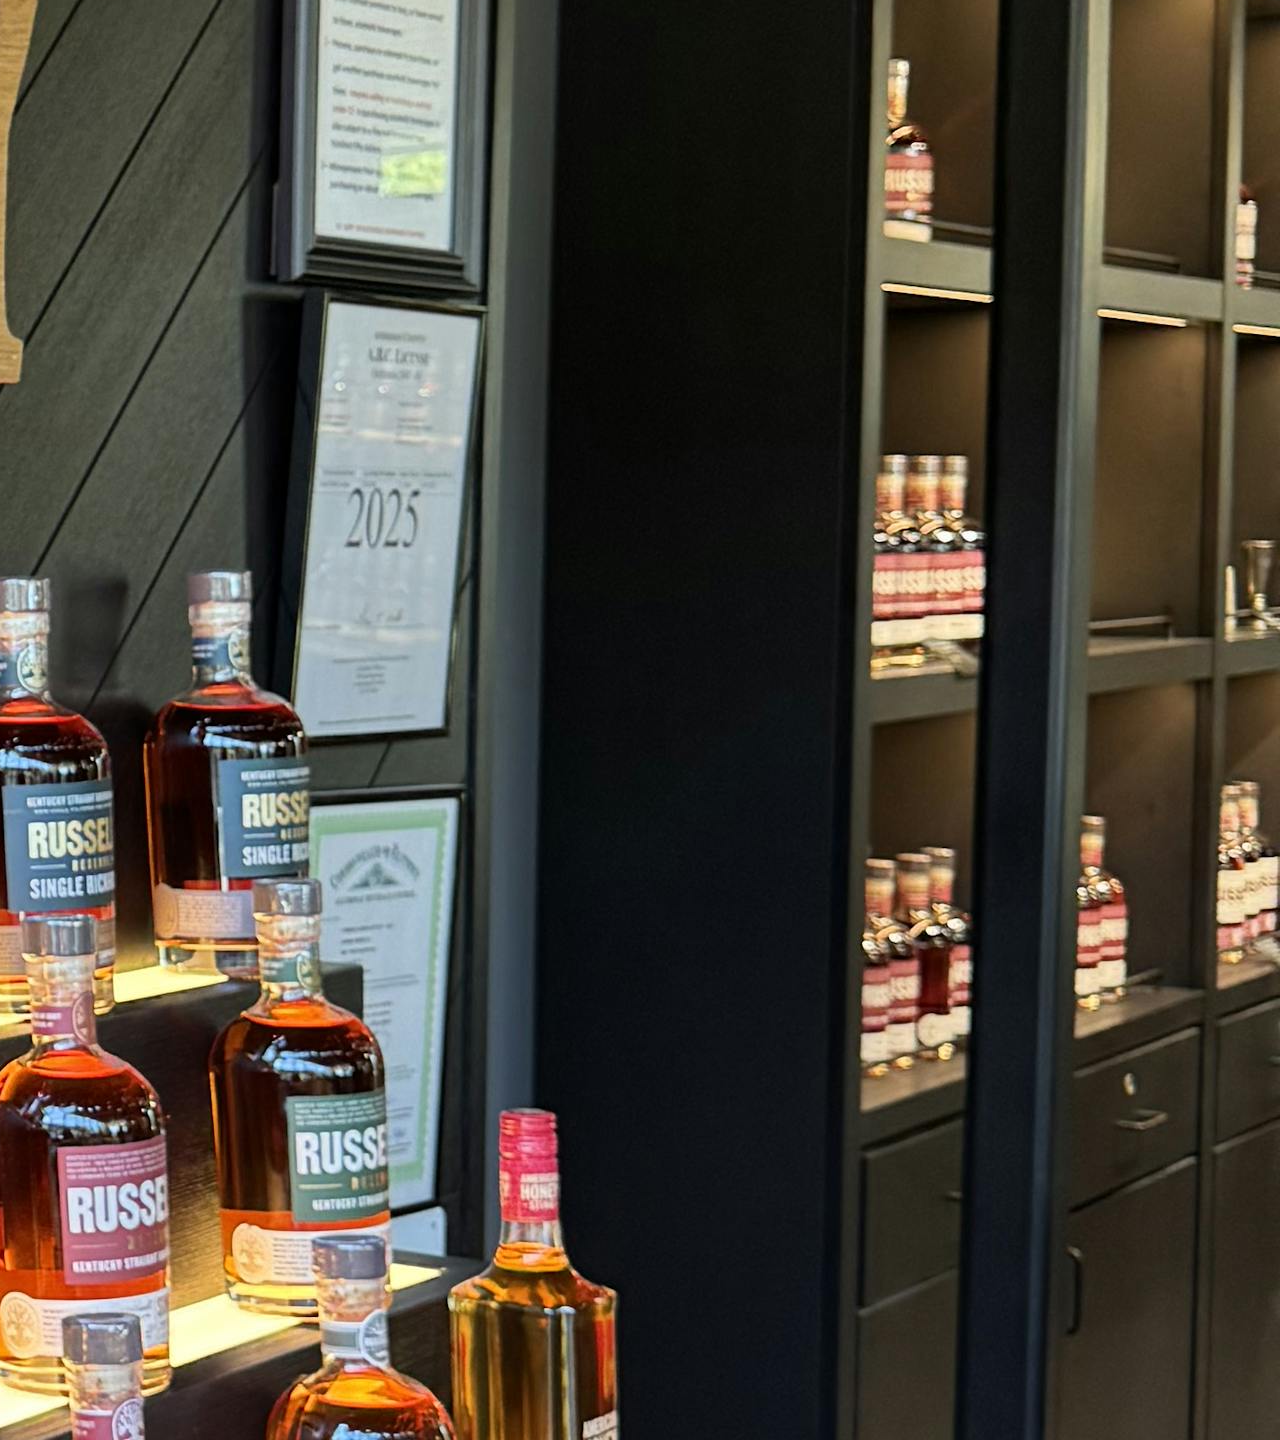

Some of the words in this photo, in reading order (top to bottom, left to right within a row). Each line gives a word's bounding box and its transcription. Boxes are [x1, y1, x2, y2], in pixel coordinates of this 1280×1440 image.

[344, 487, 421, 548] 2025
[243, 843, 291, 866] SINGLE
[30, 875, 84, 899] SINGLE
